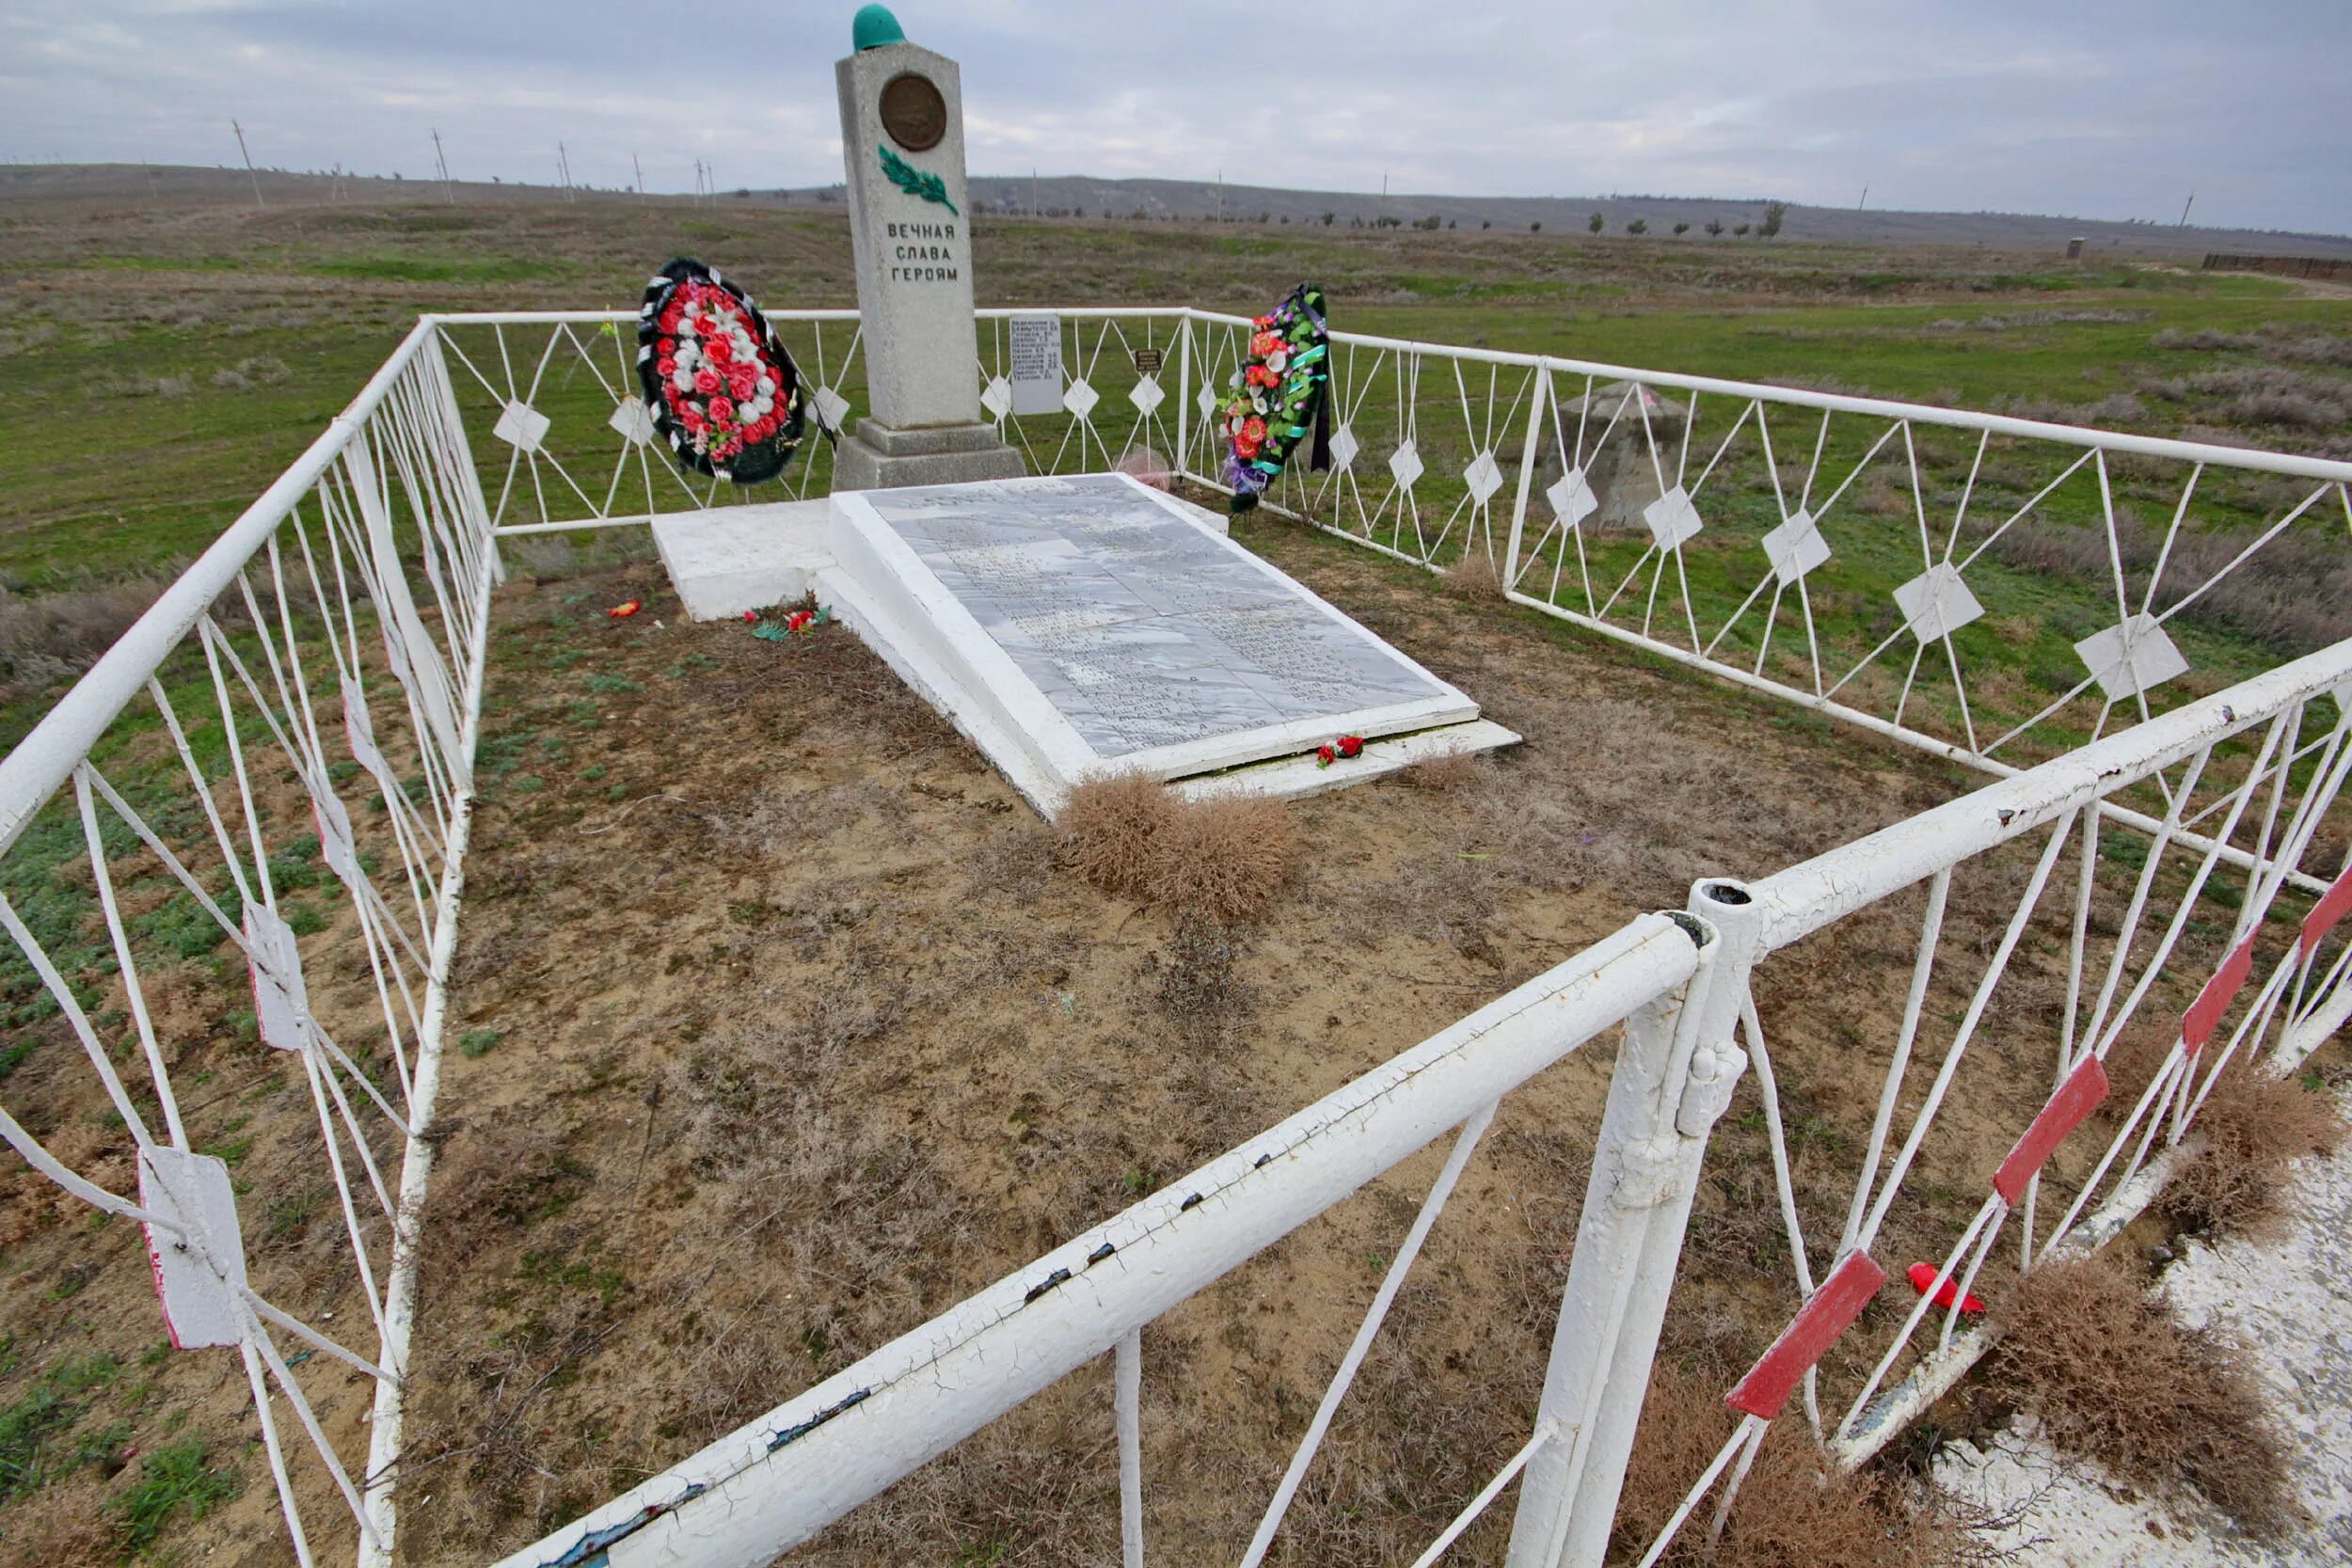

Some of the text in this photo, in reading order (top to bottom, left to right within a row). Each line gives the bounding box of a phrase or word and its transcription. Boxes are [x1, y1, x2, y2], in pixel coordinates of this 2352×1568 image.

[887, 222, 955, 239] ВЕЧНАЯ
[896, 245, 951, 261] СЛАВА
[892, 266, 958, 281] ГЕРОЯМ
